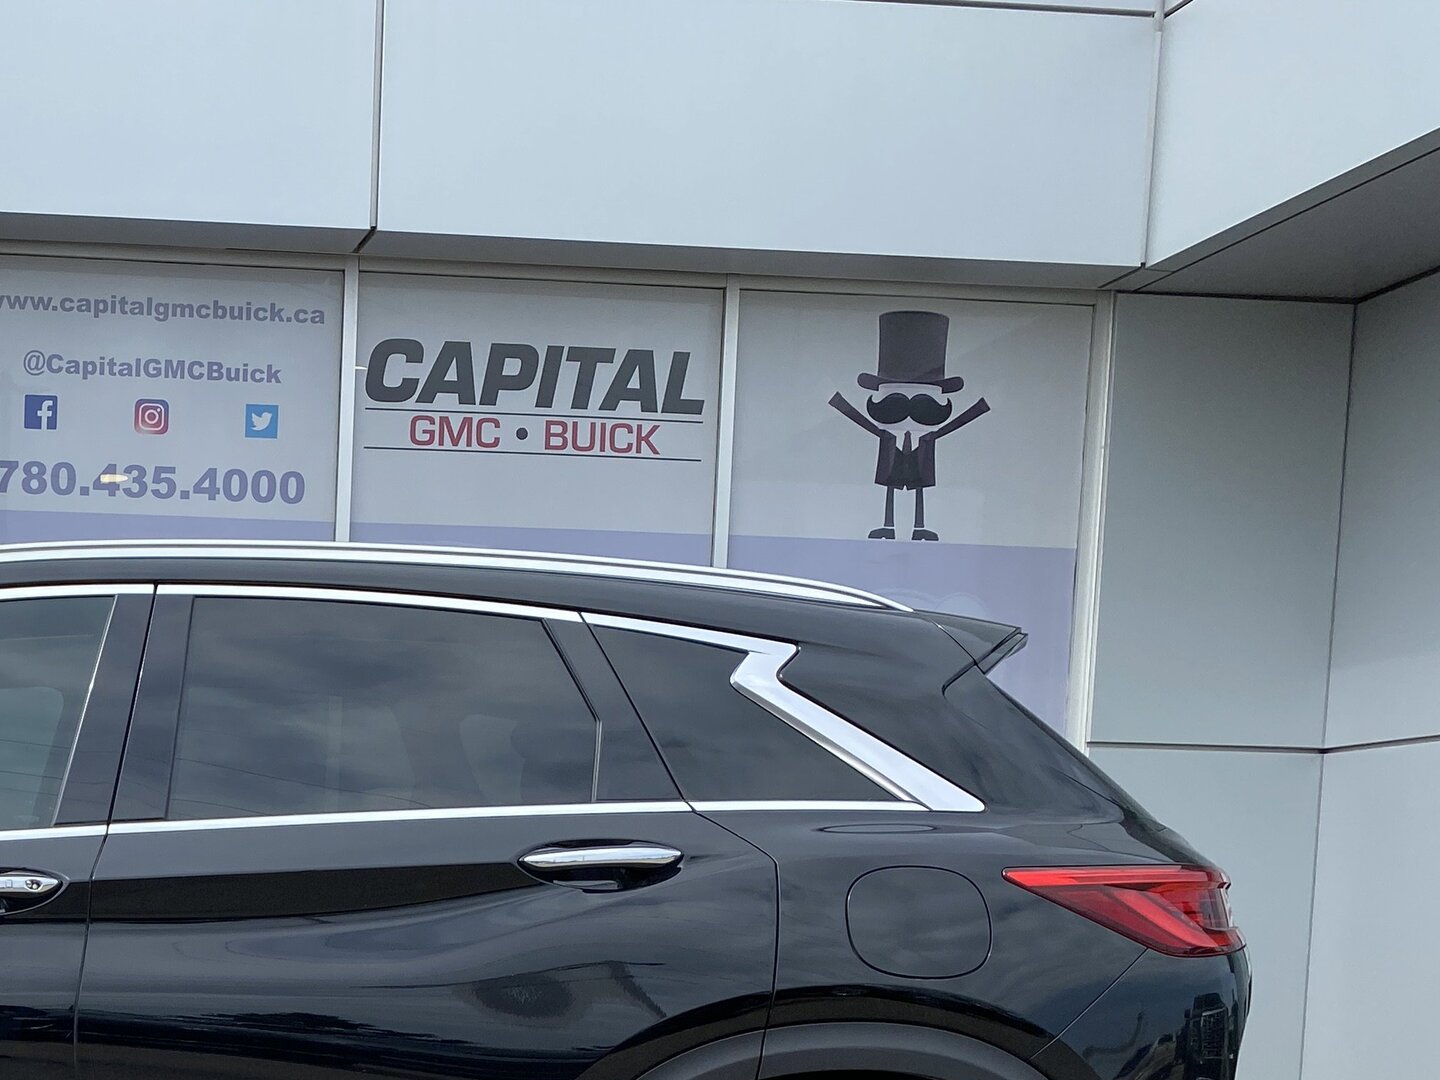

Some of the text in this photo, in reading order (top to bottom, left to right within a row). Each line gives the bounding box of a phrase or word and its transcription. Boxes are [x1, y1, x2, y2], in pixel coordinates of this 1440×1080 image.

[22, 349, 282, 384] @CapitalGMCBuick
[365, 338, 705, 415] CAPITAL
[409, 415, 661, 455] GMC BUICK
